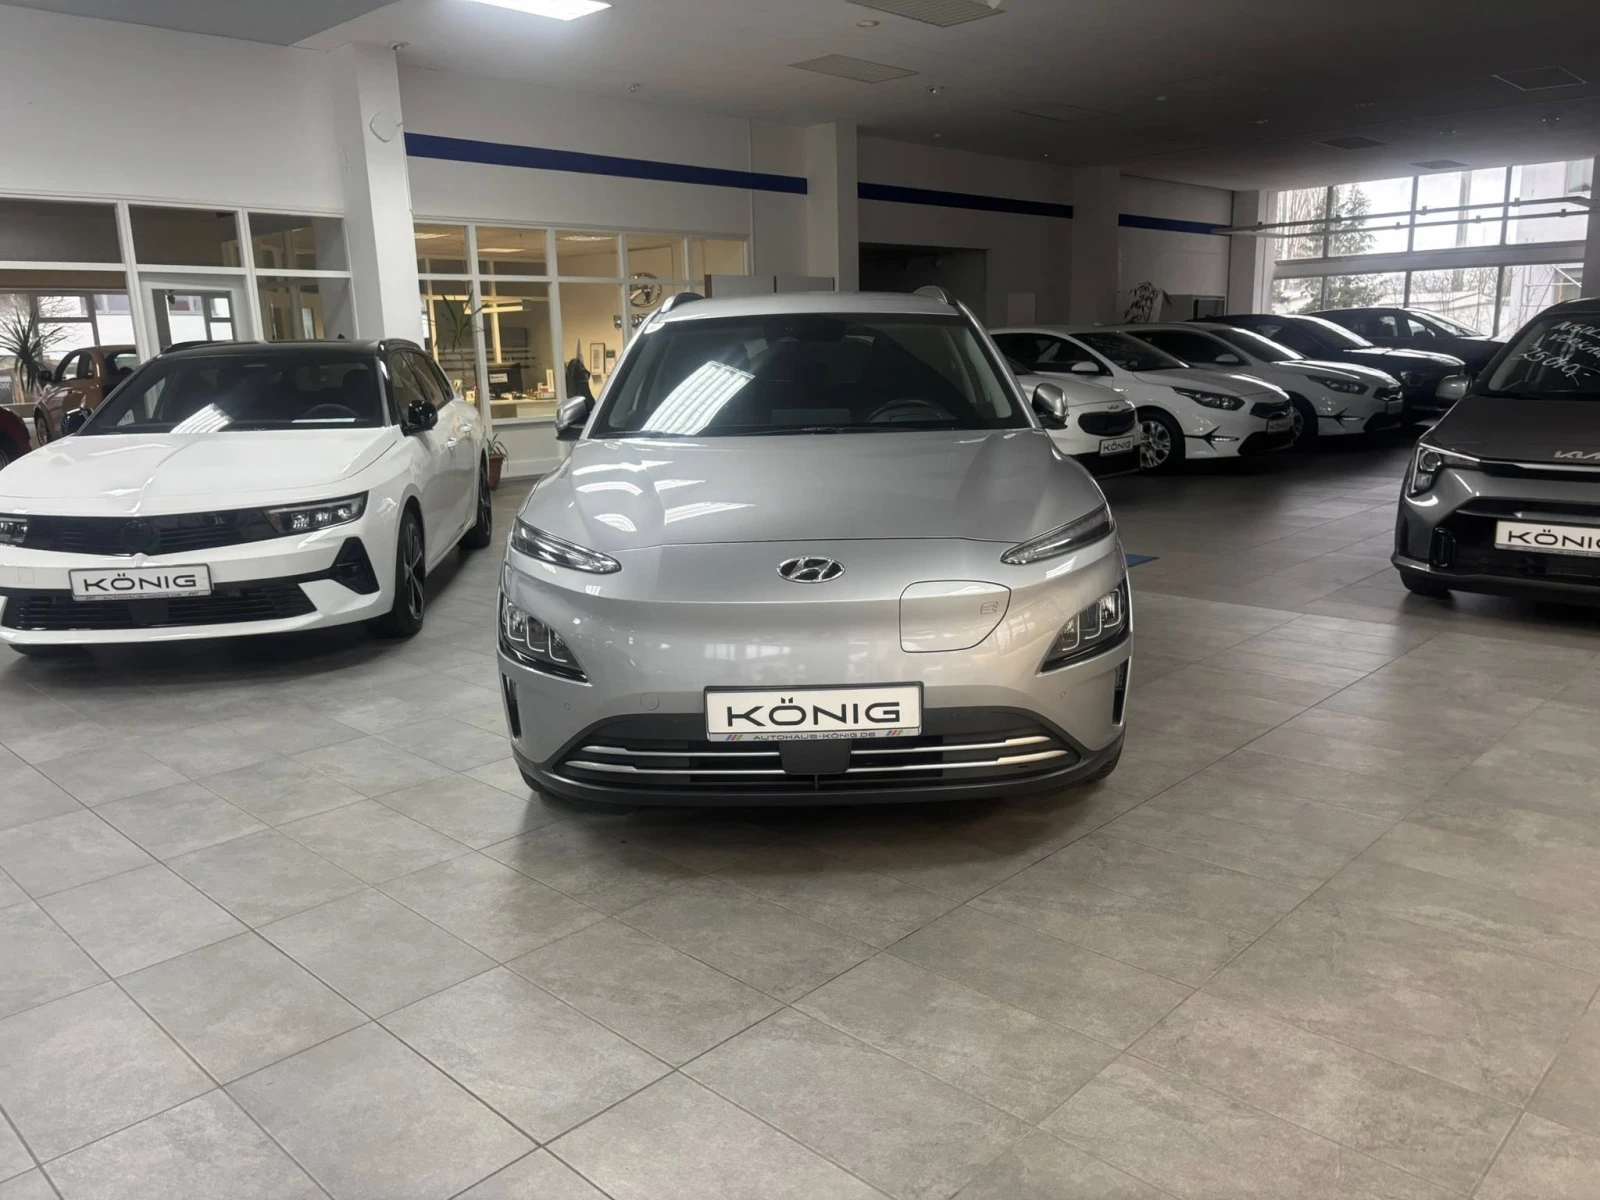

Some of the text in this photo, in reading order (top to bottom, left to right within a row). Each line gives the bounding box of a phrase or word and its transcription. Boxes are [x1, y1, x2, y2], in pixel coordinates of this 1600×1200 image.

[1103, 441, 1131, 452] KÖNIG
[1508, 529, 1600, 549] KÖNI
[83, 573, 197, 592] KÖNIG
[727, 697, 900, 727] KÖNIG
